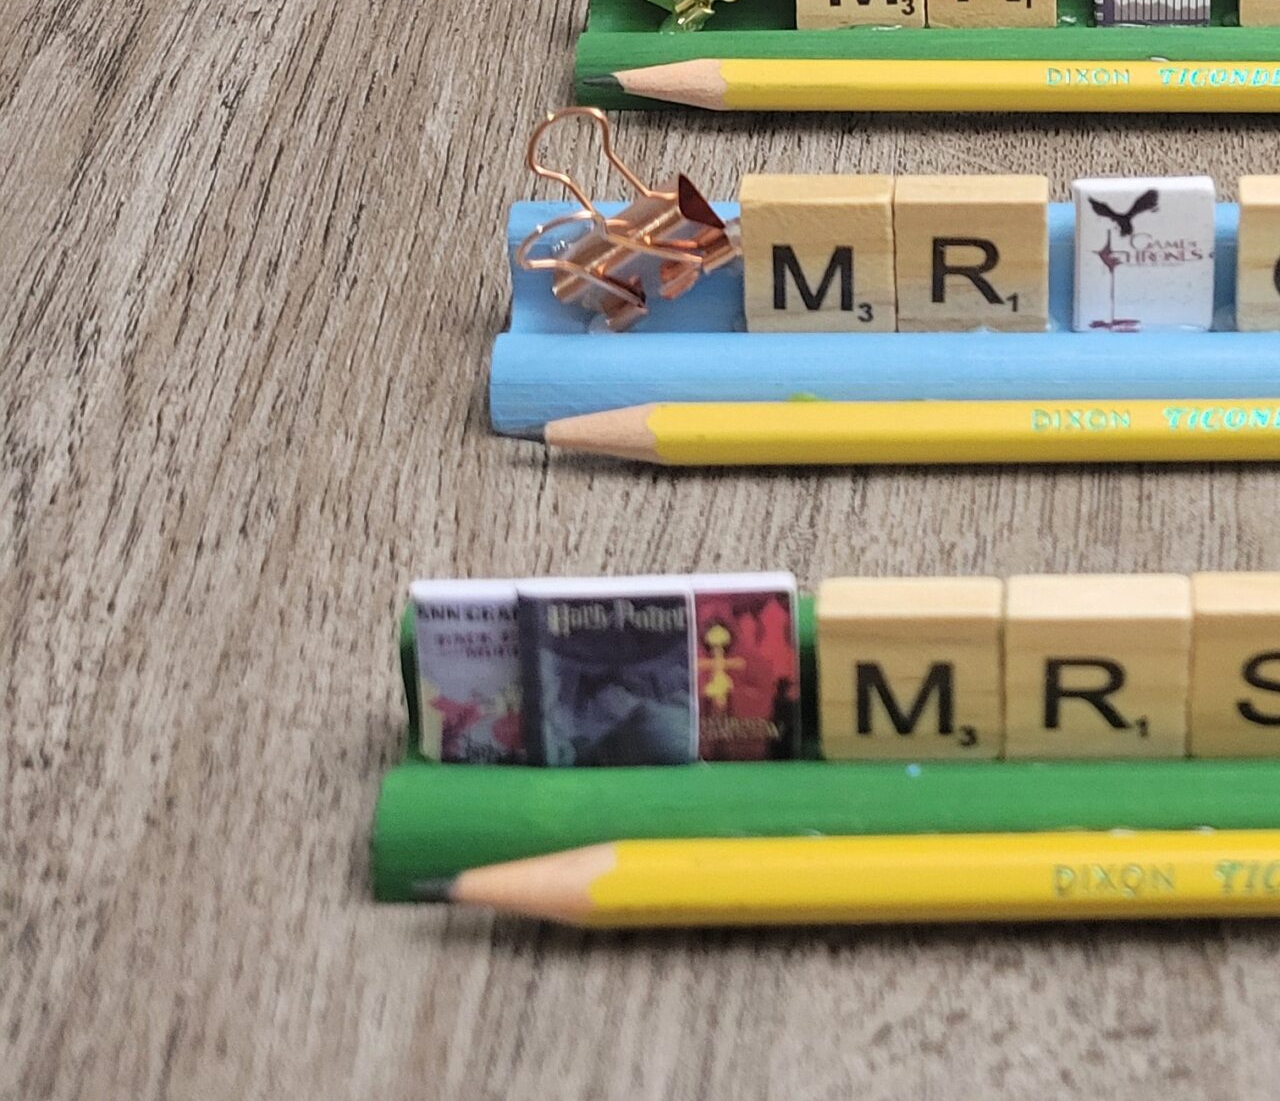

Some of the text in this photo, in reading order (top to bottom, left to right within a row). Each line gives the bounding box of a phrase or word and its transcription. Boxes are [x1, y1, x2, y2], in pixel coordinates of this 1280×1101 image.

[1046, 68, 1131, 86] DIXON
[771, 236, 1005, 312] MR
[1031, 407, 1132, 431] DIXON
[1053, 863, 1176, 898] DIXON
